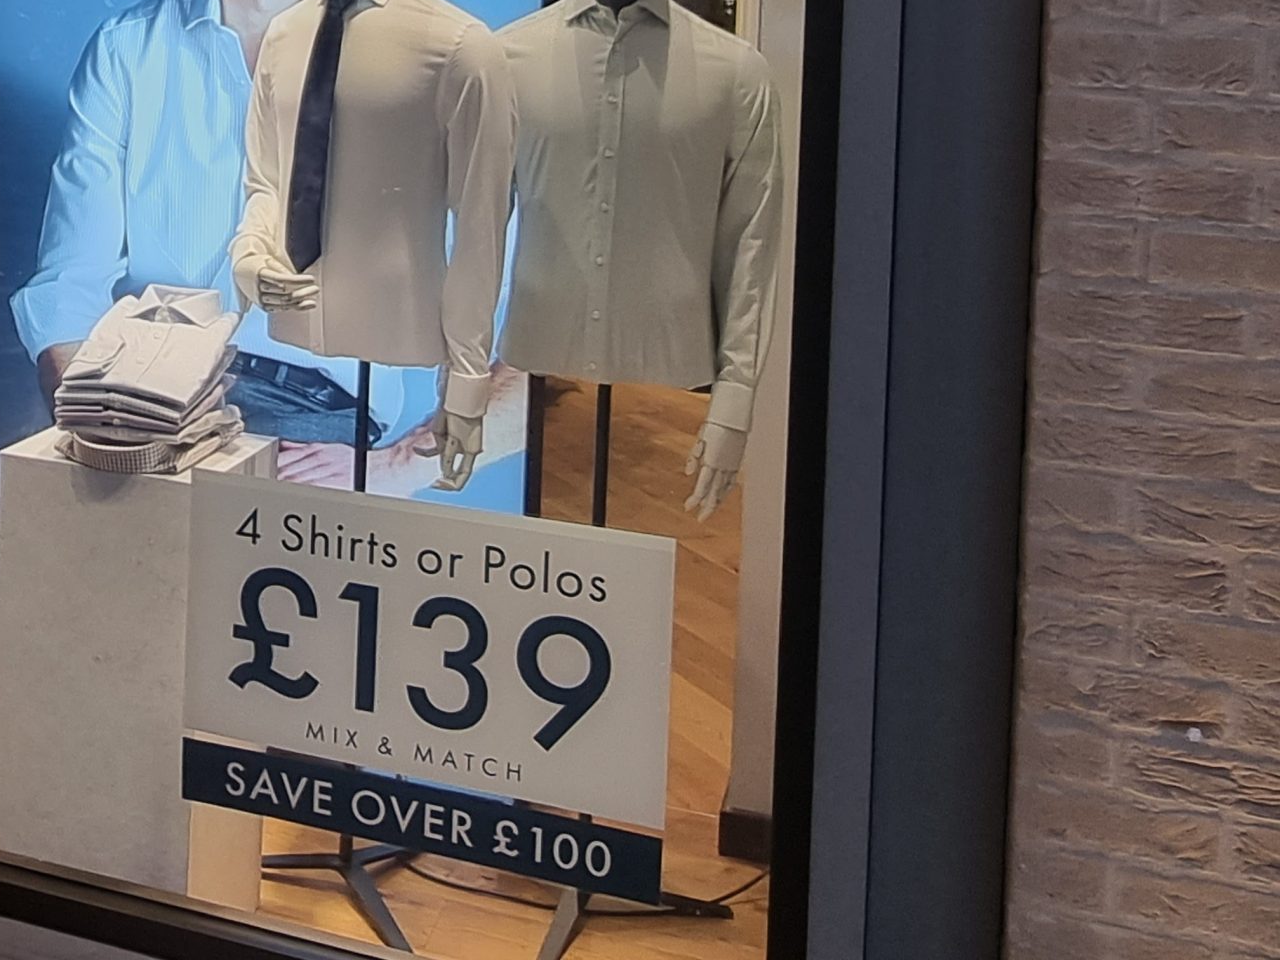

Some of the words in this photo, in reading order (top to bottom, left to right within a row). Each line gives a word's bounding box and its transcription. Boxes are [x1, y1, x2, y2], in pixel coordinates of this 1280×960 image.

[235, 508, 261, 545] 4
[281, 513, 398, 569] Shirts
[418, 549, 463, 578] or
[484, 545, 608, 603] Polos
[228, 567, 612, 752] £139
[305, 722, 359, 749] MIX
[377, 736, 392, 756] &
[413, 745, 523, 782] MATCH
[224, 762, 334, 817] SAVE
[351, 789, 473, 848] OVER
[492, 820, 612, 878] £100
